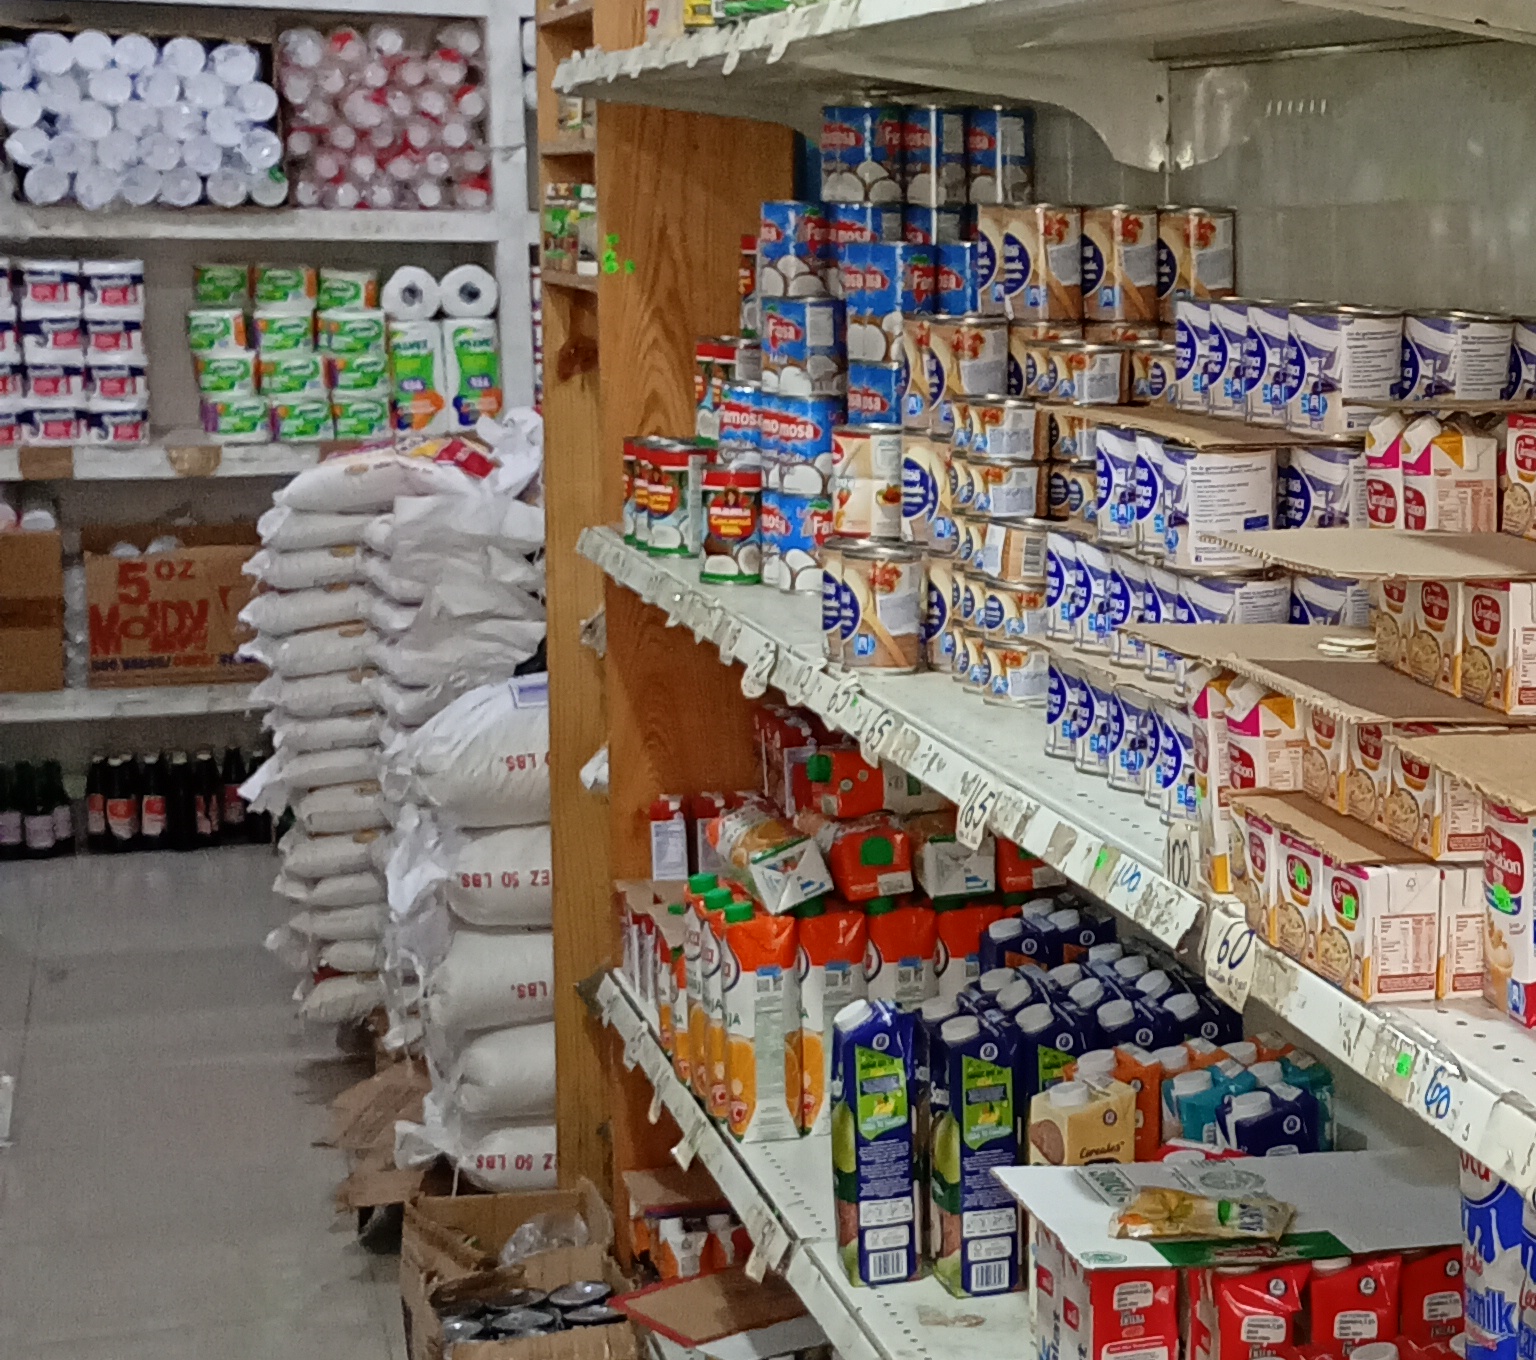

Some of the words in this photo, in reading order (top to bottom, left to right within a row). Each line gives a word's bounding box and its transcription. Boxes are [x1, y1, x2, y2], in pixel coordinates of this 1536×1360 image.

[118, 562, 150, 606] 5
[154, 559, 196, 581] OZ
[502, 871, 520, 889] 50
[1217, 921, 1256, 971] 60
